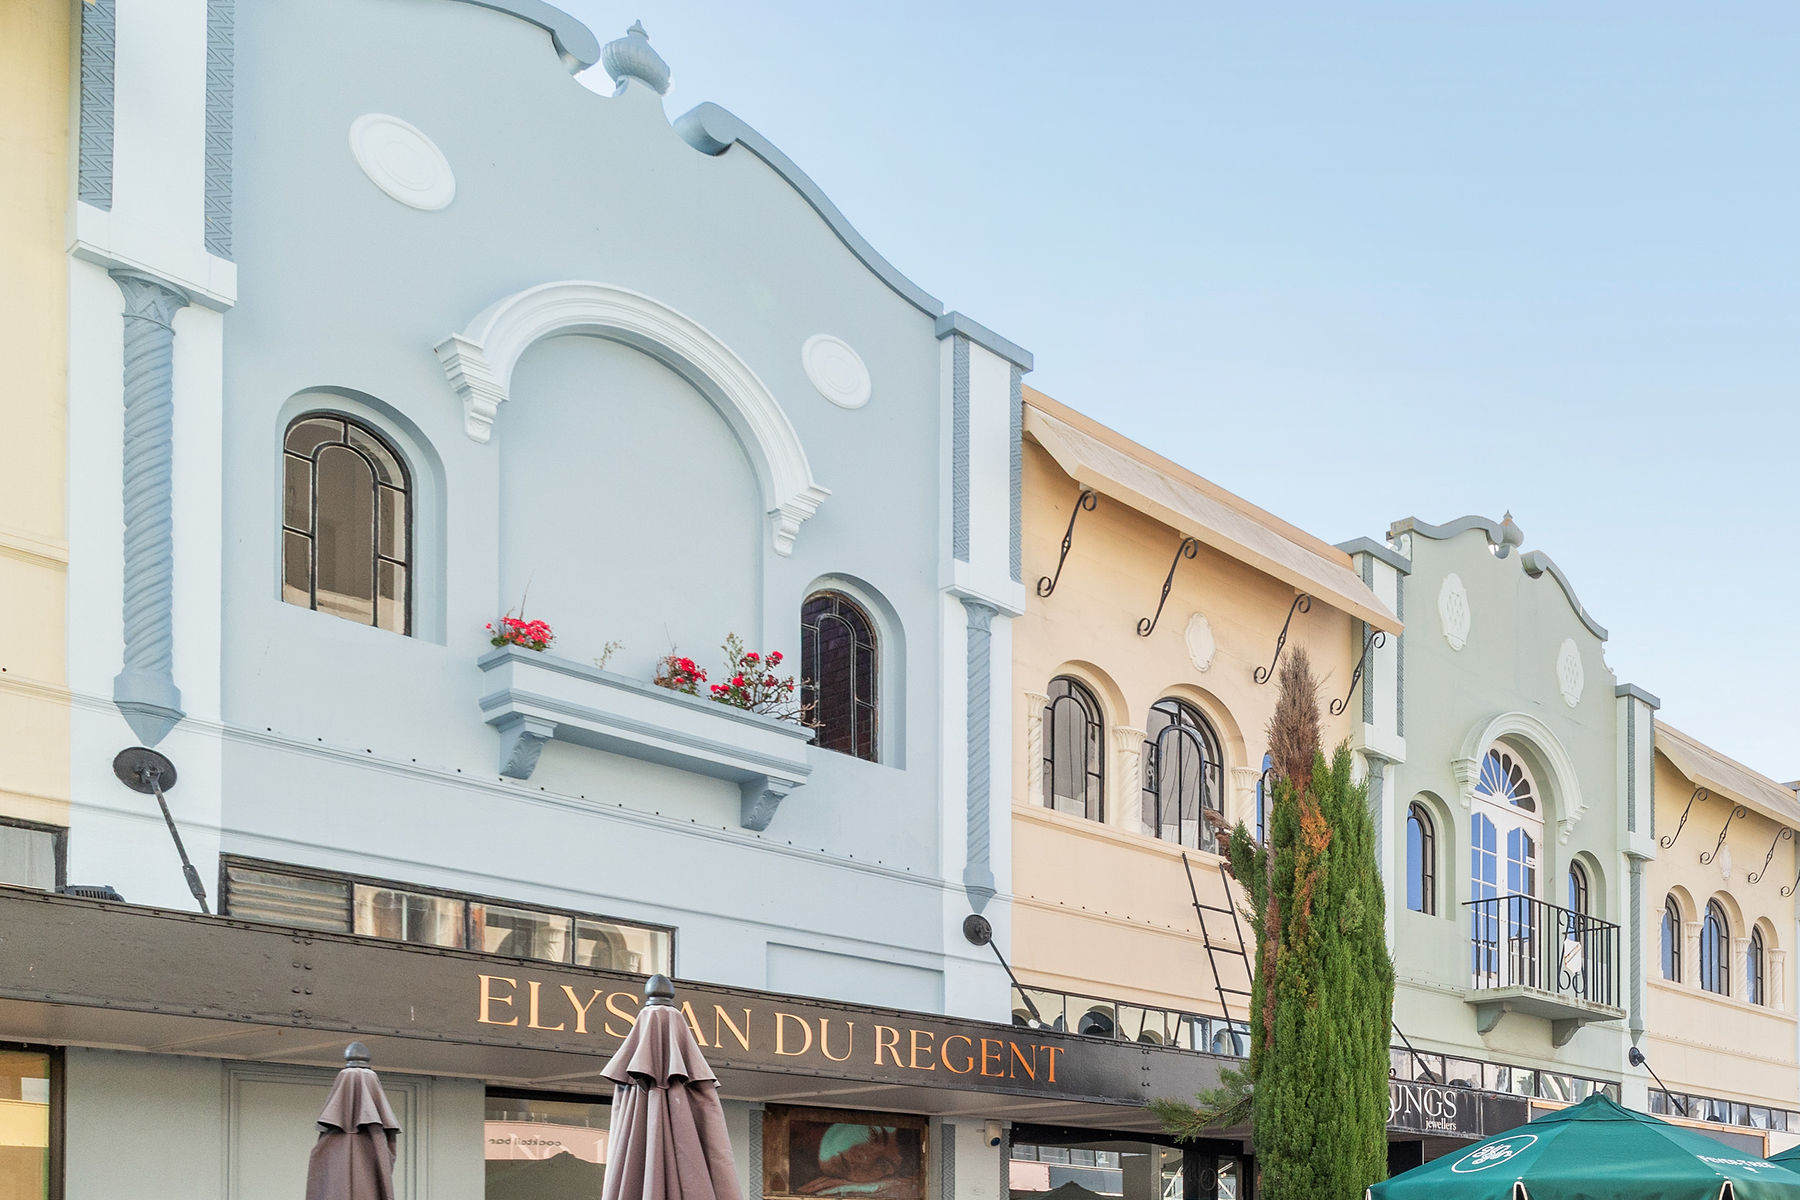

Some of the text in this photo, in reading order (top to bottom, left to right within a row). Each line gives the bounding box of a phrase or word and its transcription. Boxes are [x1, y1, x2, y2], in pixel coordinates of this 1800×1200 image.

[478, 974, 1065, 1084] ELYSAN DU REGENT
[1388, 1084, 1458, 1122] UNGS
[1425, 1117, 1457, 1131] jewellers
